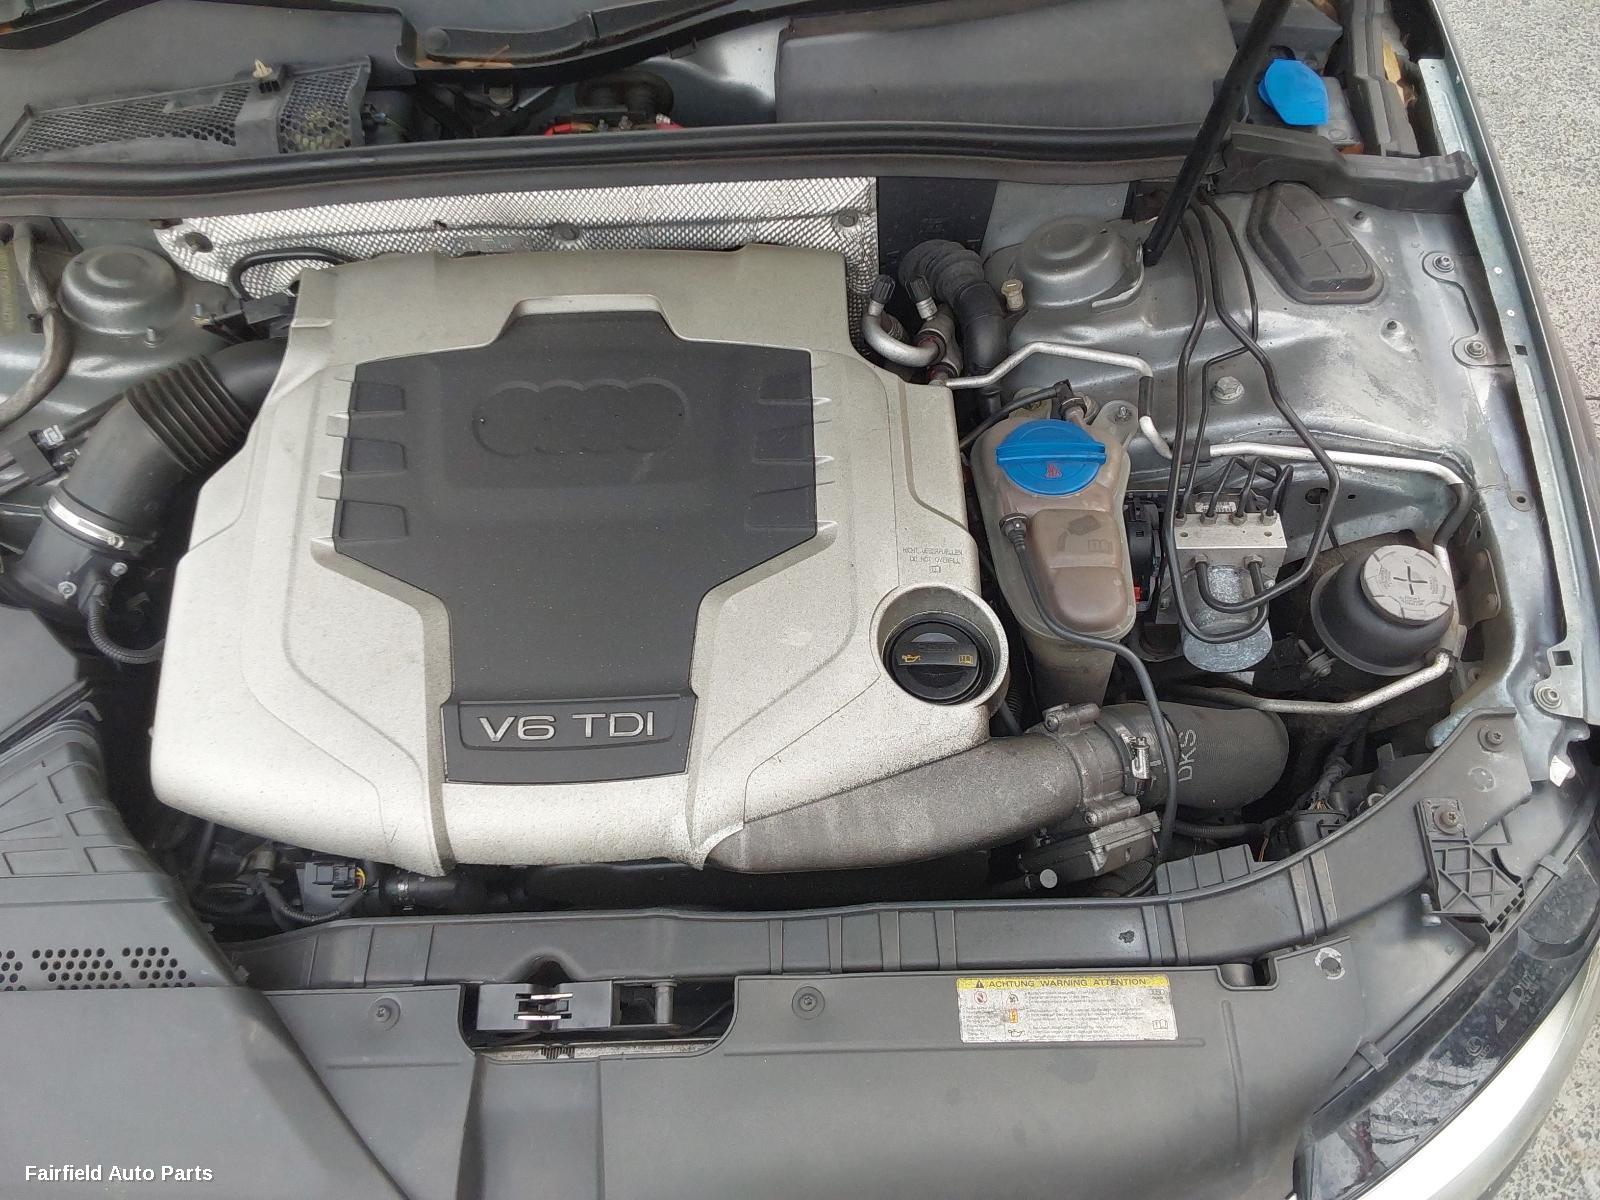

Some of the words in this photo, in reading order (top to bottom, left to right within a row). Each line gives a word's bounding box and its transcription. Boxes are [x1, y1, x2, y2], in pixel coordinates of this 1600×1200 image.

[479, 715, 556, 742] V6
[572, 711, 655, 738] TDI
[1177, 729, 1197, 782] DKS
[988, 980, 1035, 988] ACHTUNG
[1040, 979, 1088, 987] WARNING
[1093, 978, 1147, 986] ATTENTION
